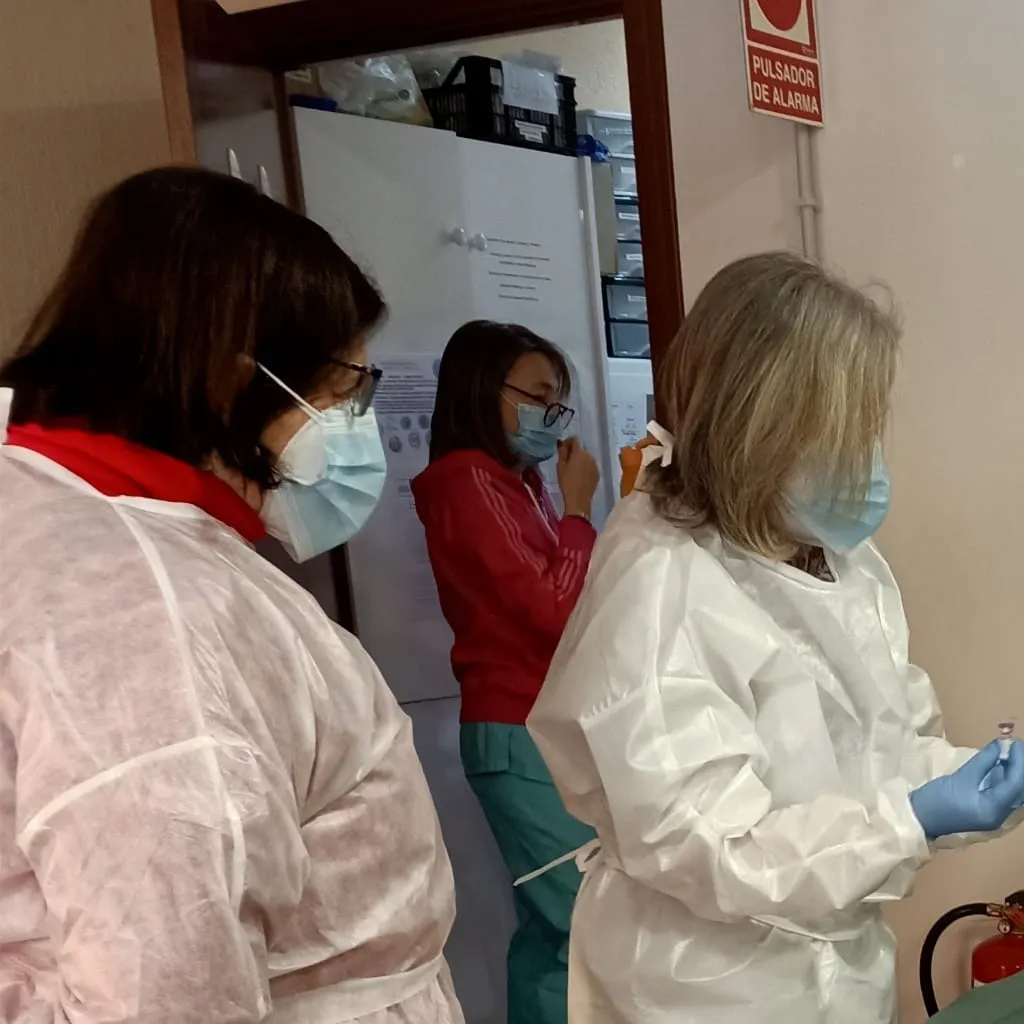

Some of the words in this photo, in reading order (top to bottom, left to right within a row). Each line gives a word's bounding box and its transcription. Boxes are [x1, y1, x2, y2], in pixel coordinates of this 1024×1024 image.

[752, 55, 815, 88] PULSADOR
[752, 81, 770, 104] DE
[773, 86, 819, 114] ALARMA
